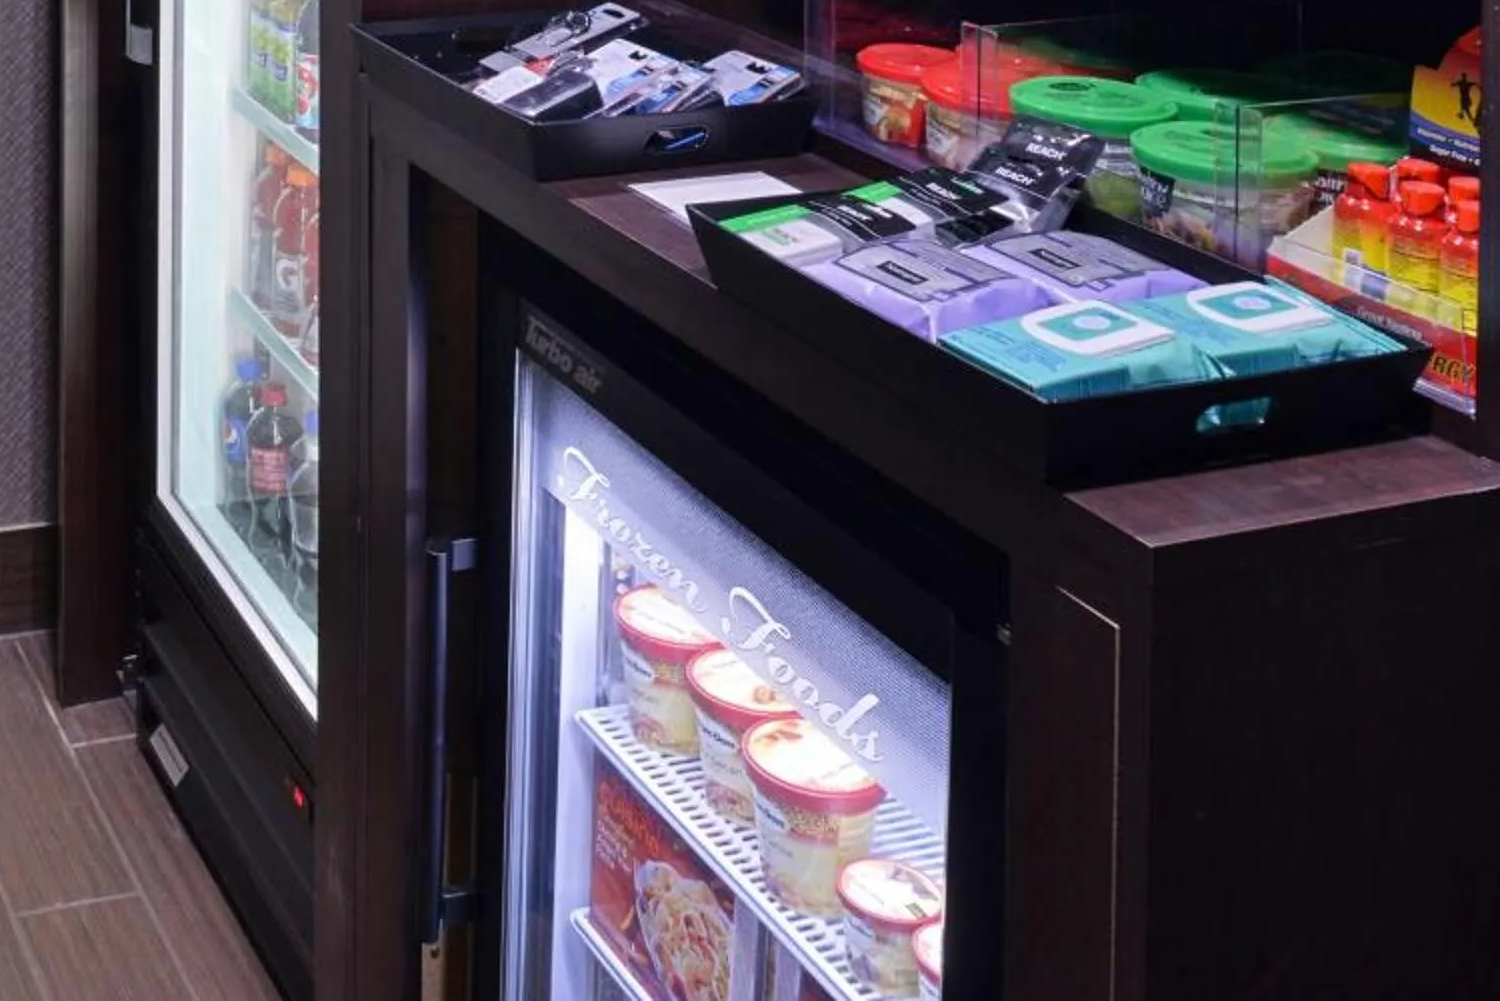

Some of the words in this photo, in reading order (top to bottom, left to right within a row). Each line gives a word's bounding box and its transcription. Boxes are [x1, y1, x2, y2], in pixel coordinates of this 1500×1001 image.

[1025, 143, 1067, 160] REACH
[995, 167, 1036, 186] REACH
[557, 446, 708, 615] Frozen
[721, 586, 885, 764] Foods
